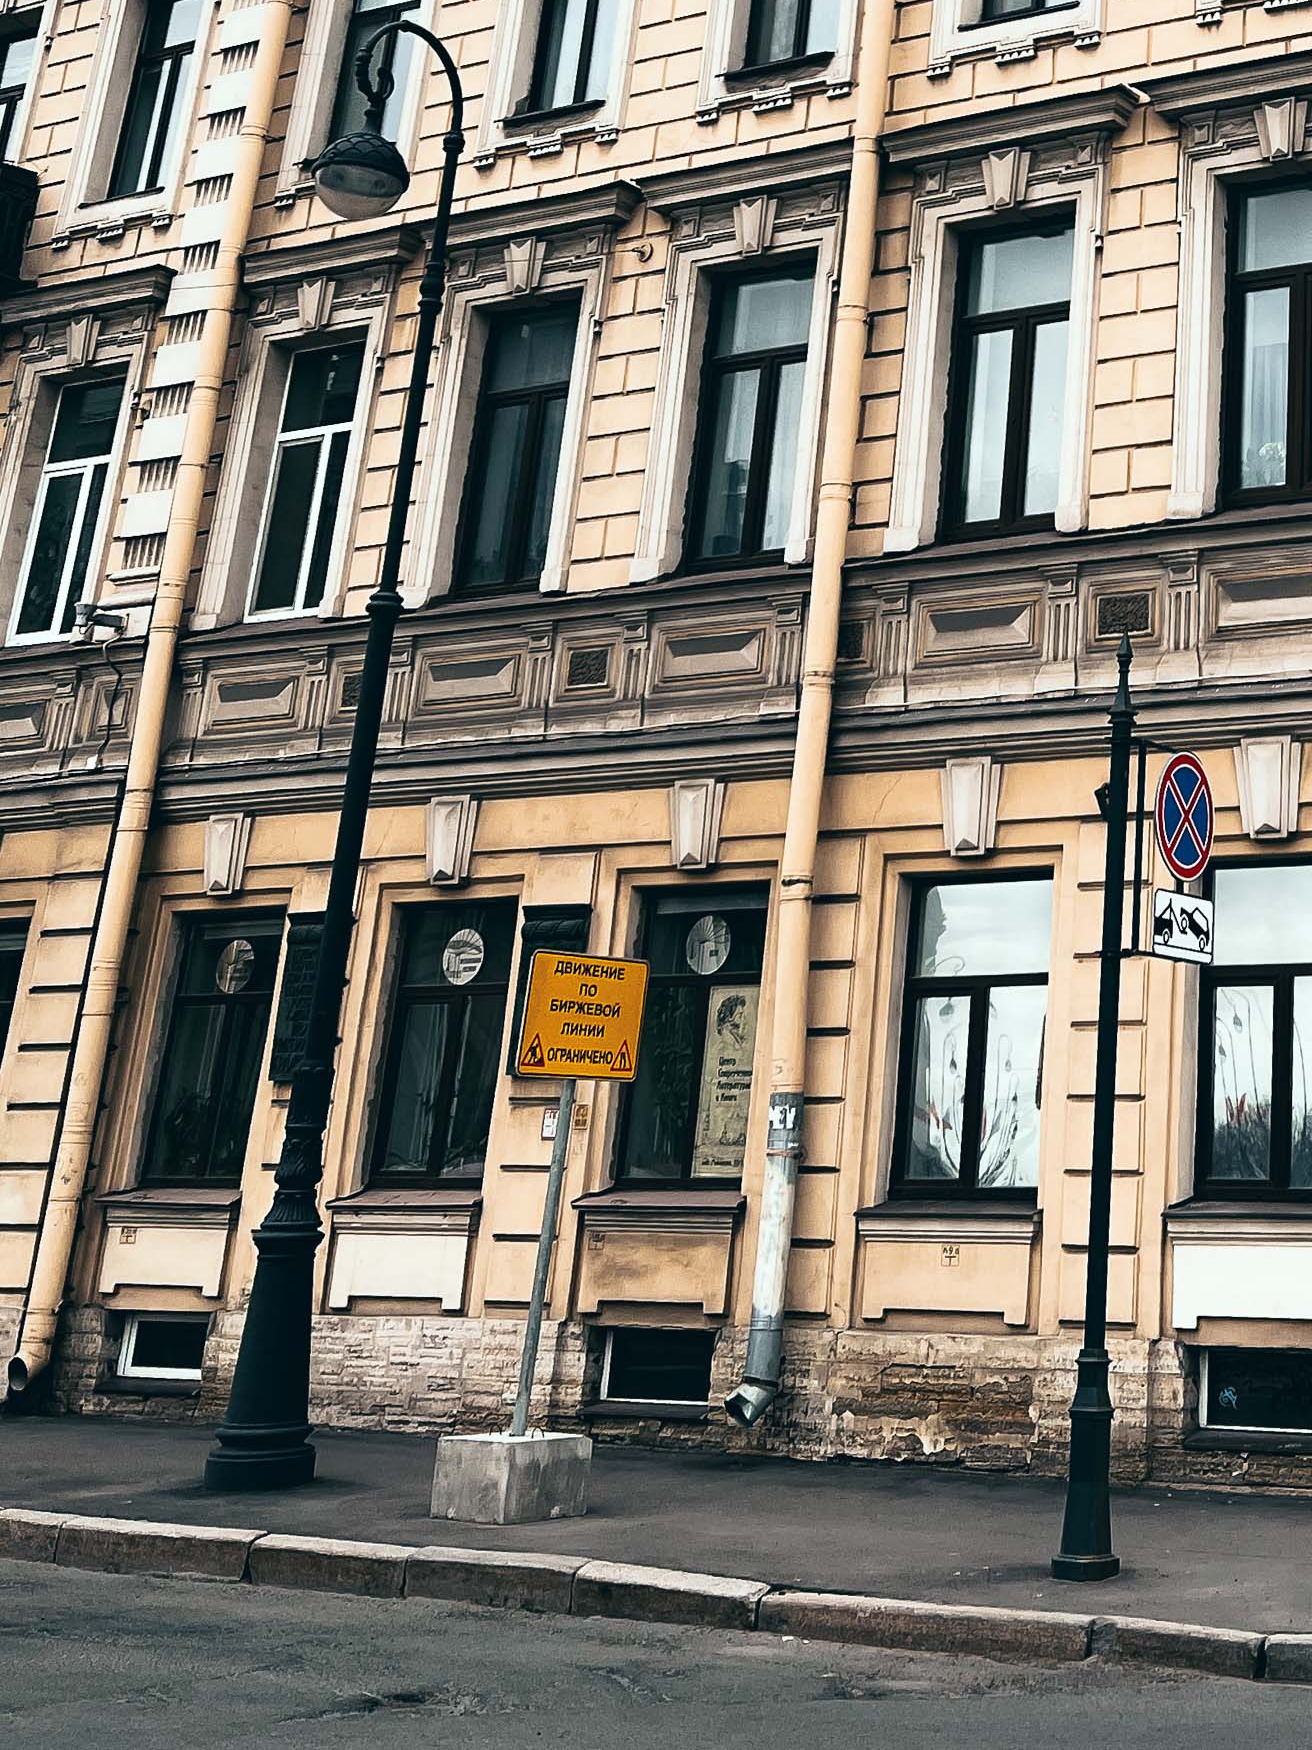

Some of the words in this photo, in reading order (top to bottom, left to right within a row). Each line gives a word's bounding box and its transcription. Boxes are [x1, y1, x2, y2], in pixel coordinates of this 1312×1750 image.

[554, 961, 625, 980] ДВИЖЕНИЕ
[579, 983, 598, 997] ПО
[549, 999, 621, 1018] БИРЖЕВОЙ
[561, 1022, 605, 1037] ЛИНИИ
[547, 1047, 613, 1065] ОГРАНИЧЕНО
